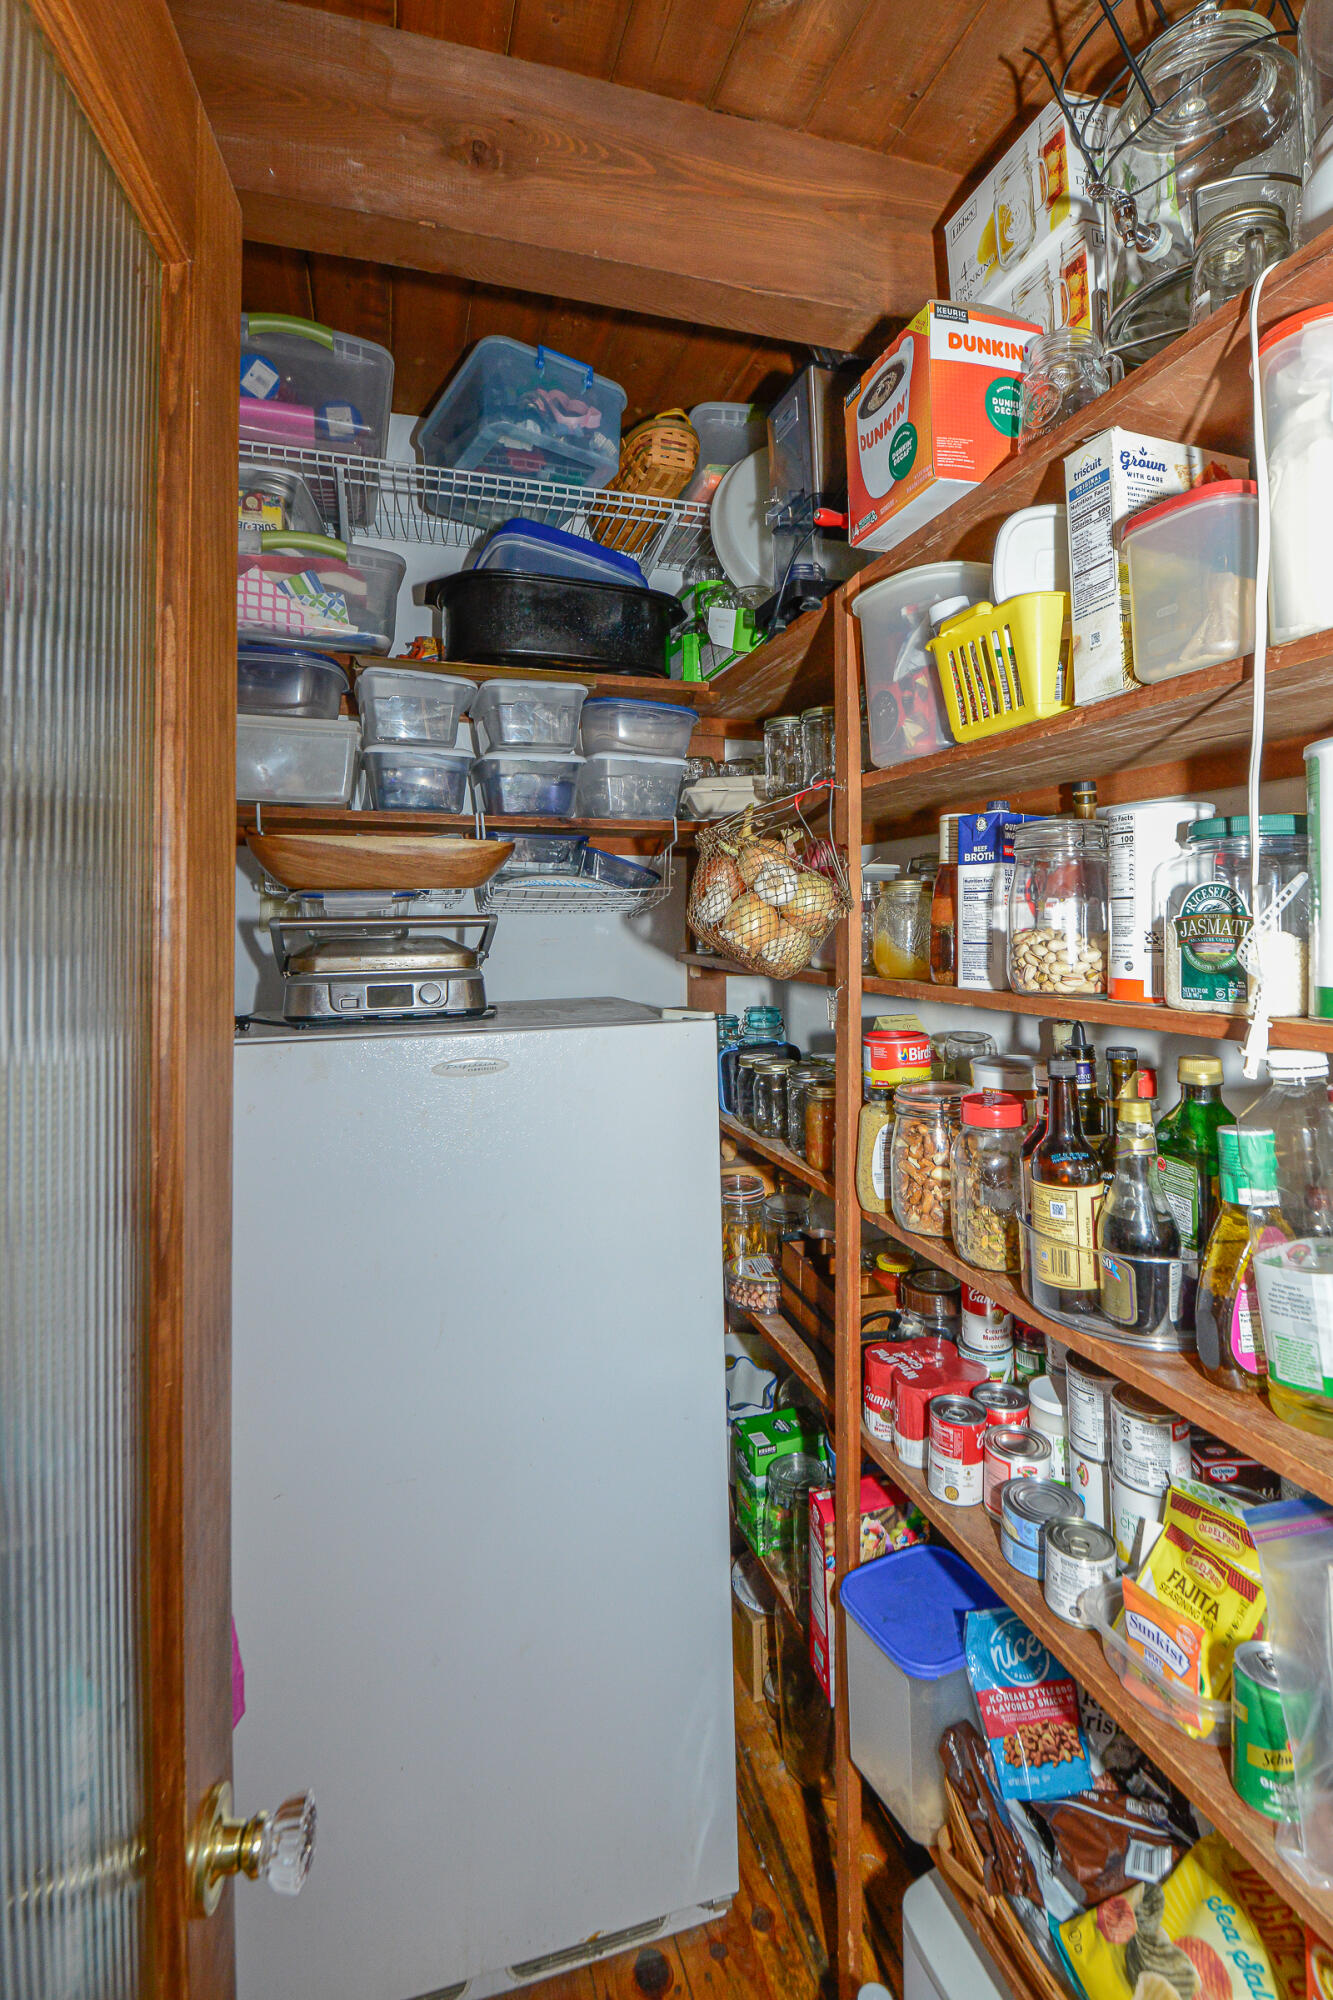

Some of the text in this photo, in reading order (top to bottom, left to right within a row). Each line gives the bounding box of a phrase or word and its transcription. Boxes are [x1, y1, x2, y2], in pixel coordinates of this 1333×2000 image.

[936, 305, 967, 318] KEURIG
[860, 388, 908, 451] DUNKIN'
[1073, 457, 1102, 481] triscuit
[1120, 450, 1168, 473] Grown
[1126, 471, 1164, 484] WITH CARE
[1094, 485, 1110, 498] Facts
[1098, 505, 1110, 517] 120
[1120, 835, 1134, 844] 100
[964, 852, 995, 862] BROTH
[1180, 918, 1250, 938] JASMATI
[1160, 1583, 1201, 1620] SEASONING
[1167, 1567, 1220, 1622] FAJITA
[1129, 1613, 1183, 1667] Sunkist
[989, 1690, 1027, 1705] KOREAN
[985, 1700, 1035, 1716] FLAVORED
[1203, 1895, 1275, 2000] Sea Sal
